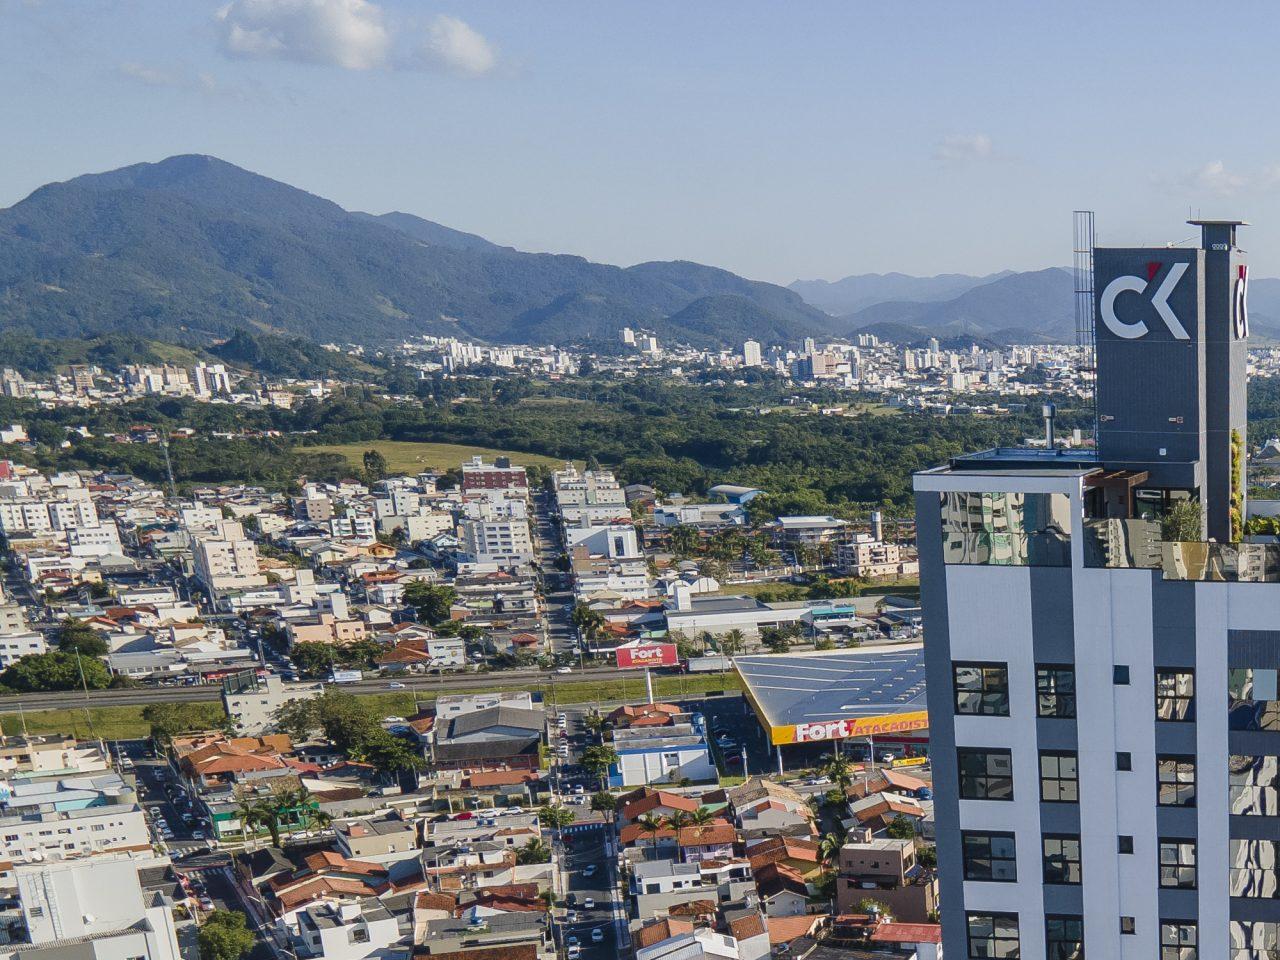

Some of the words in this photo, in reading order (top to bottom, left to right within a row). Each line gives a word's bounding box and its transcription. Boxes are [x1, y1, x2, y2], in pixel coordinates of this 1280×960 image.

[1100, 262, 1191, 340] CK
[630, 647, 663, 659] Fort
[796, 719, 850, 742] Fort
